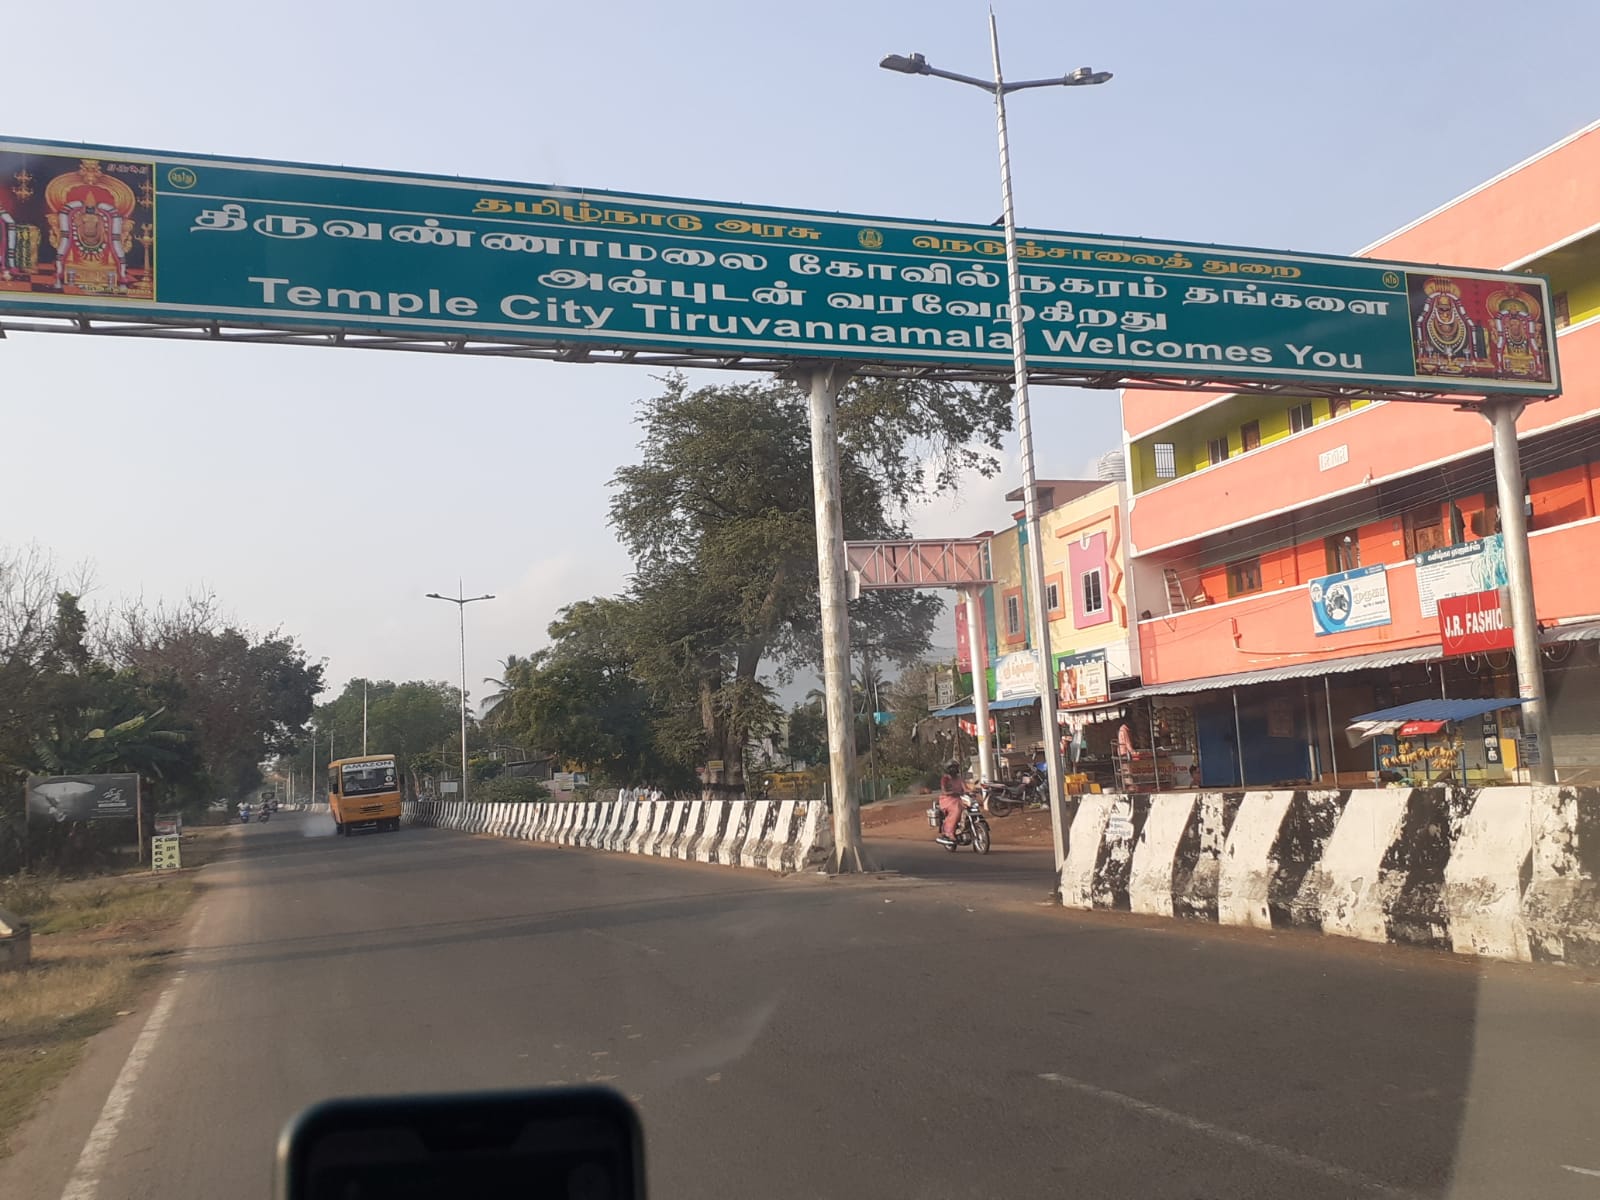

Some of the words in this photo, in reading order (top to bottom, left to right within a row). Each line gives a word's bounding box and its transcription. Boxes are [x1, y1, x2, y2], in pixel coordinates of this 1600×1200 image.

[471, 198, 703, 232] தமிழ்நாடு
[714, 219, 822, 240] அரசு
[190, 203, 768, 271] திருவண்ணாமலை
[789, 253, 1000, 288] கோவில்
[1017, 274, 1168, 299] நகரம்
[1182, 284, 1390, 316] தங்களை
[912, 235, 1193, 269] நெடுஞ்சாலைத்
[1202, 260, 1302, 279] துறை
[537, 268, 807, 306] அன்புடன்
[248, 276, 478, 317] Temple
[500, 294, 614, 329] City
[1041, 329, 1273, 363] Welcomes
[1285, 343, 1363, 370] You
[1465, 607, 1513, 635] FASHIO
[154, 837, 163, 869] XEROX
